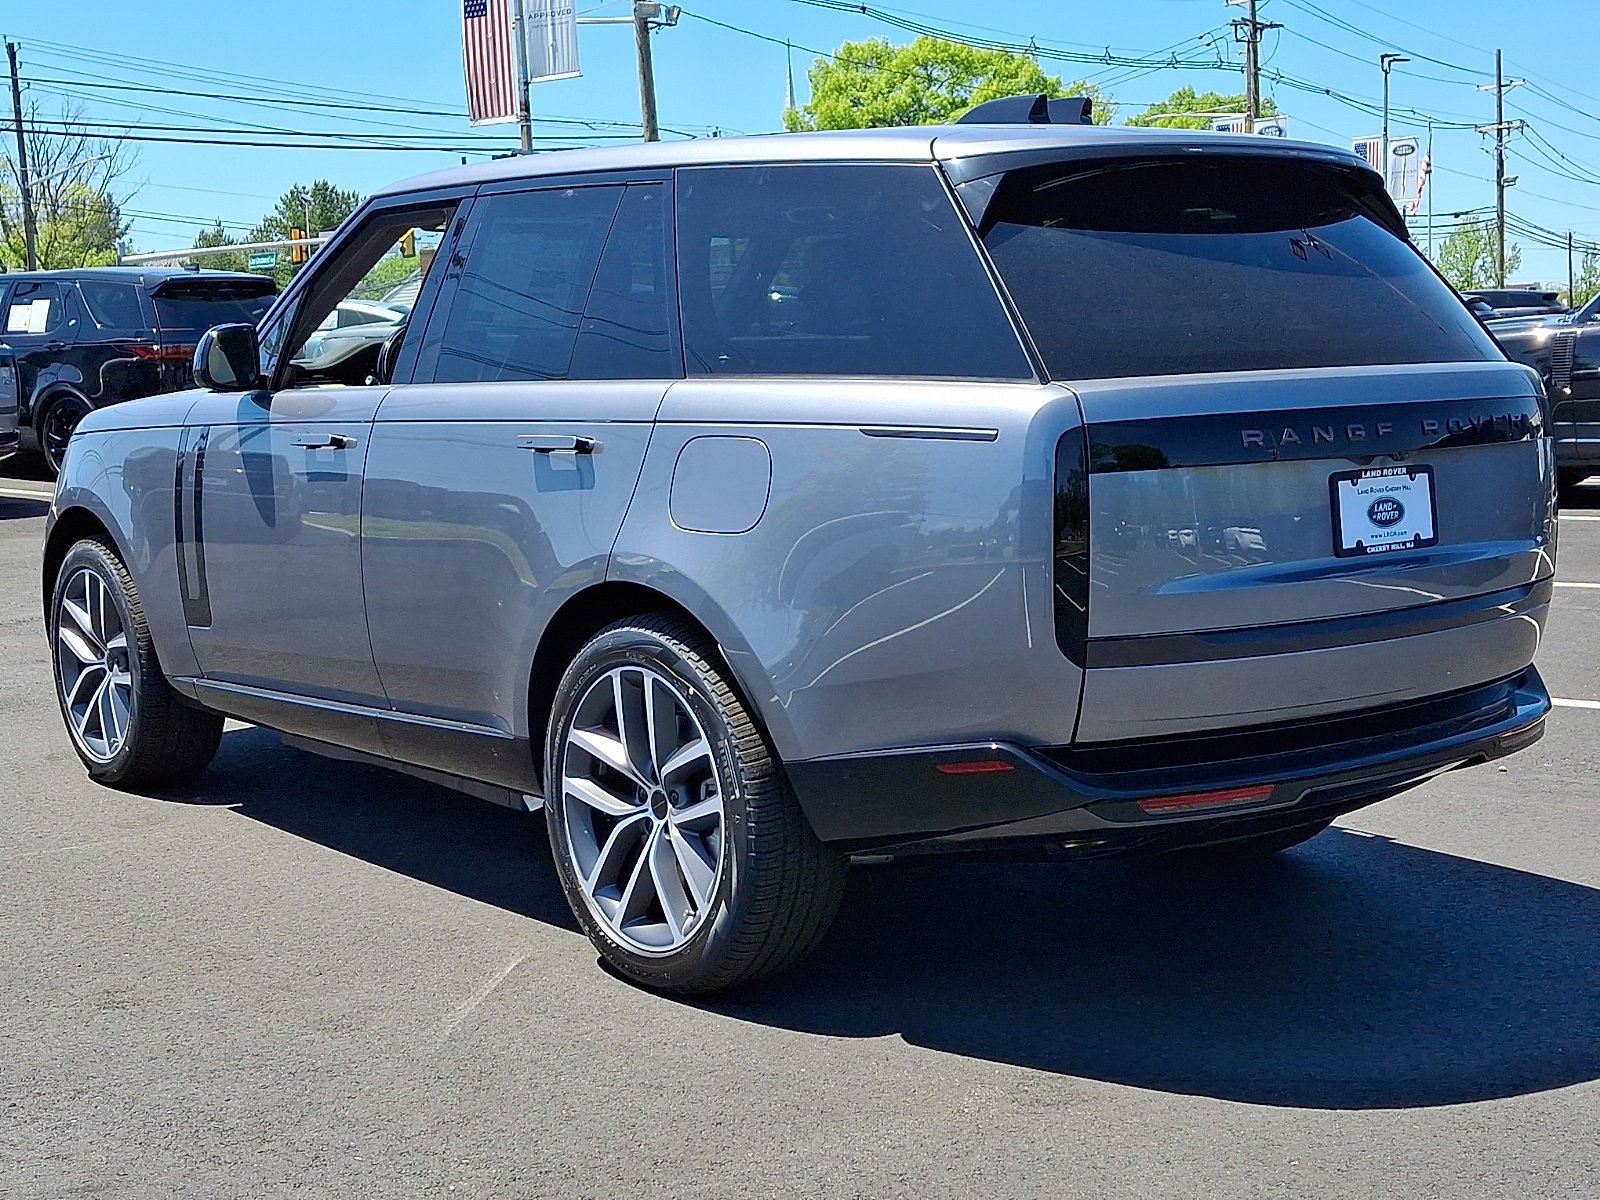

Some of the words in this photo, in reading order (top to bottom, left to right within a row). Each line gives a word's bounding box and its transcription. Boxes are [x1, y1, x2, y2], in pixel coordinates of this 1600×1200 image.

[1240, 422, 1393, 448] RANGE
[1362, 469, 1381, 478] LAND
[1383, 467, 1407, 476] ROVER
[1374, 502, 1392, 512] LAND
[1376, 511, 1399, 521] ROVER
[1367, 545, 1390, 553] CHERRY
